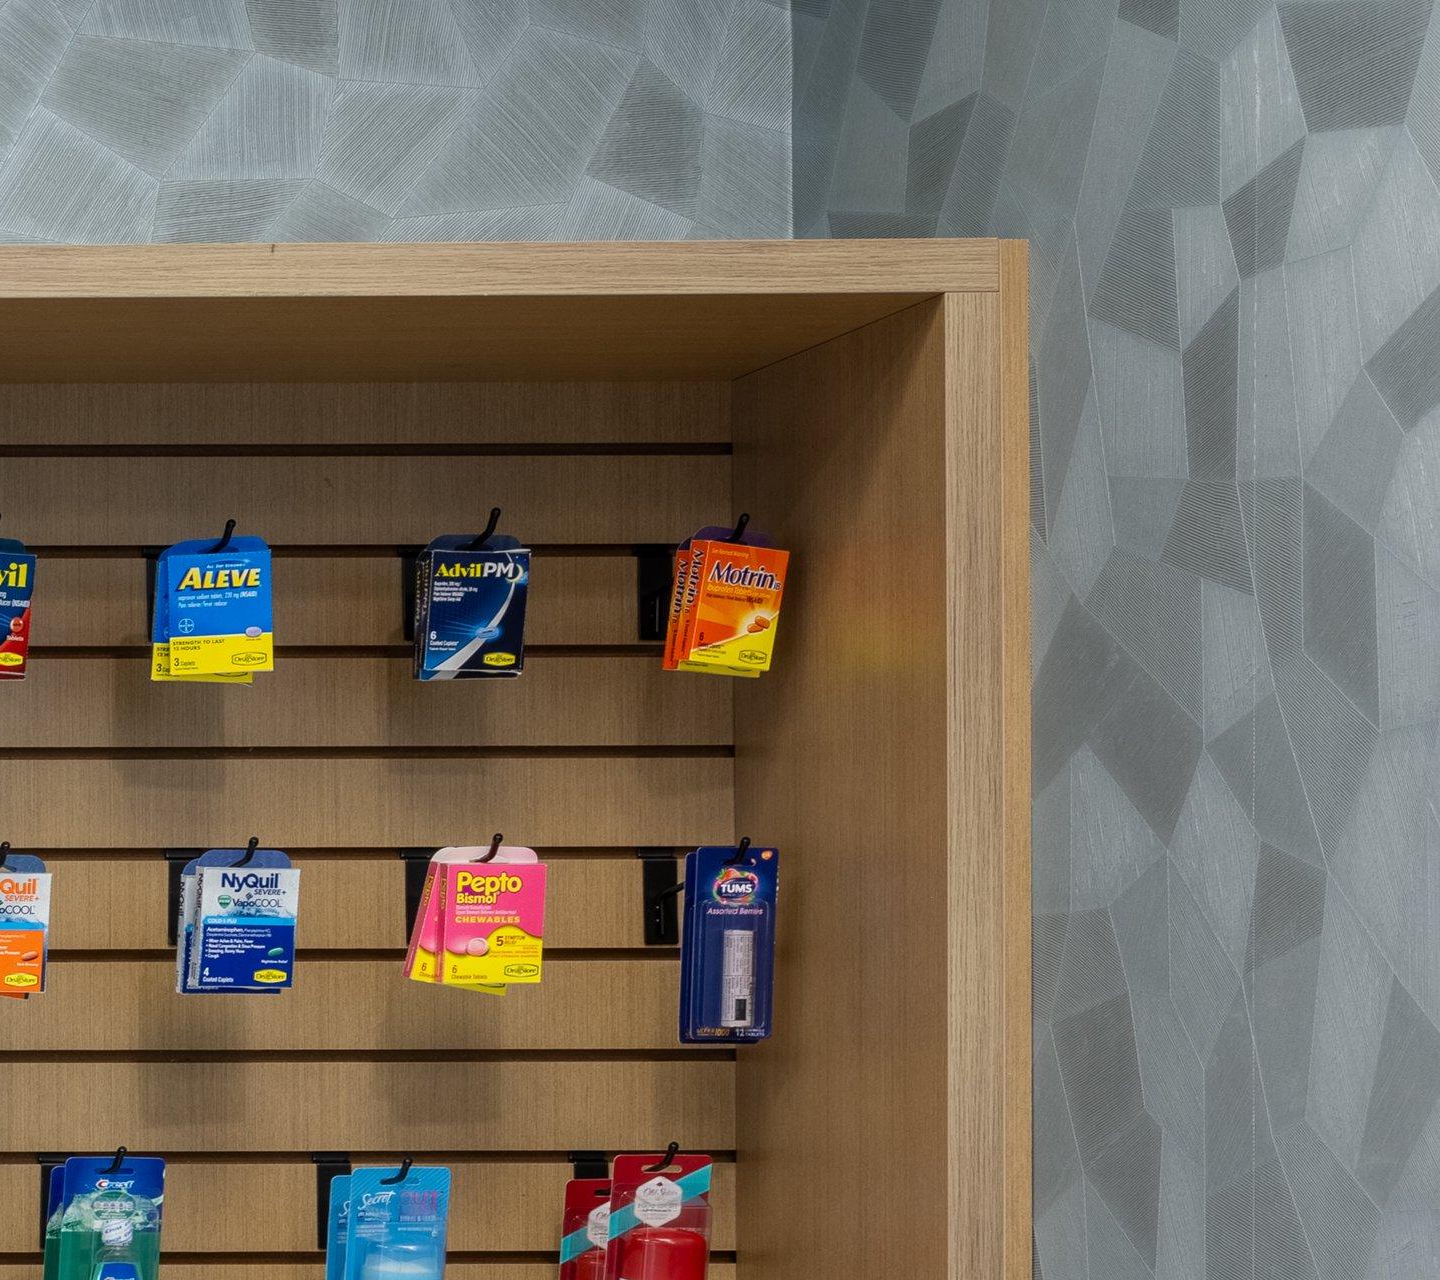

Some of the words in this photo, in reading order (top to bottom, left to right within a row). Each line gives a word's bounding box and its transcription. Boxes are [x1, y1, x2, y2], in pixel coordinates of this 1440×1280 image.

[178, 566, 261, 591] ALEVE
[710, 562, 774, 588] Motrin
[221, 873, 279, 893] NyQuil
[456, 871, 522, 901] Pepto
[721, 884, 752, 893] TUMS
[231, 898, 282, 908] VapoCOOL
[456, 892, 498, 905] Bismol
[455, 916, 520, 924] CHEWABLES
[361, 1190, 396, 1207] Secret
